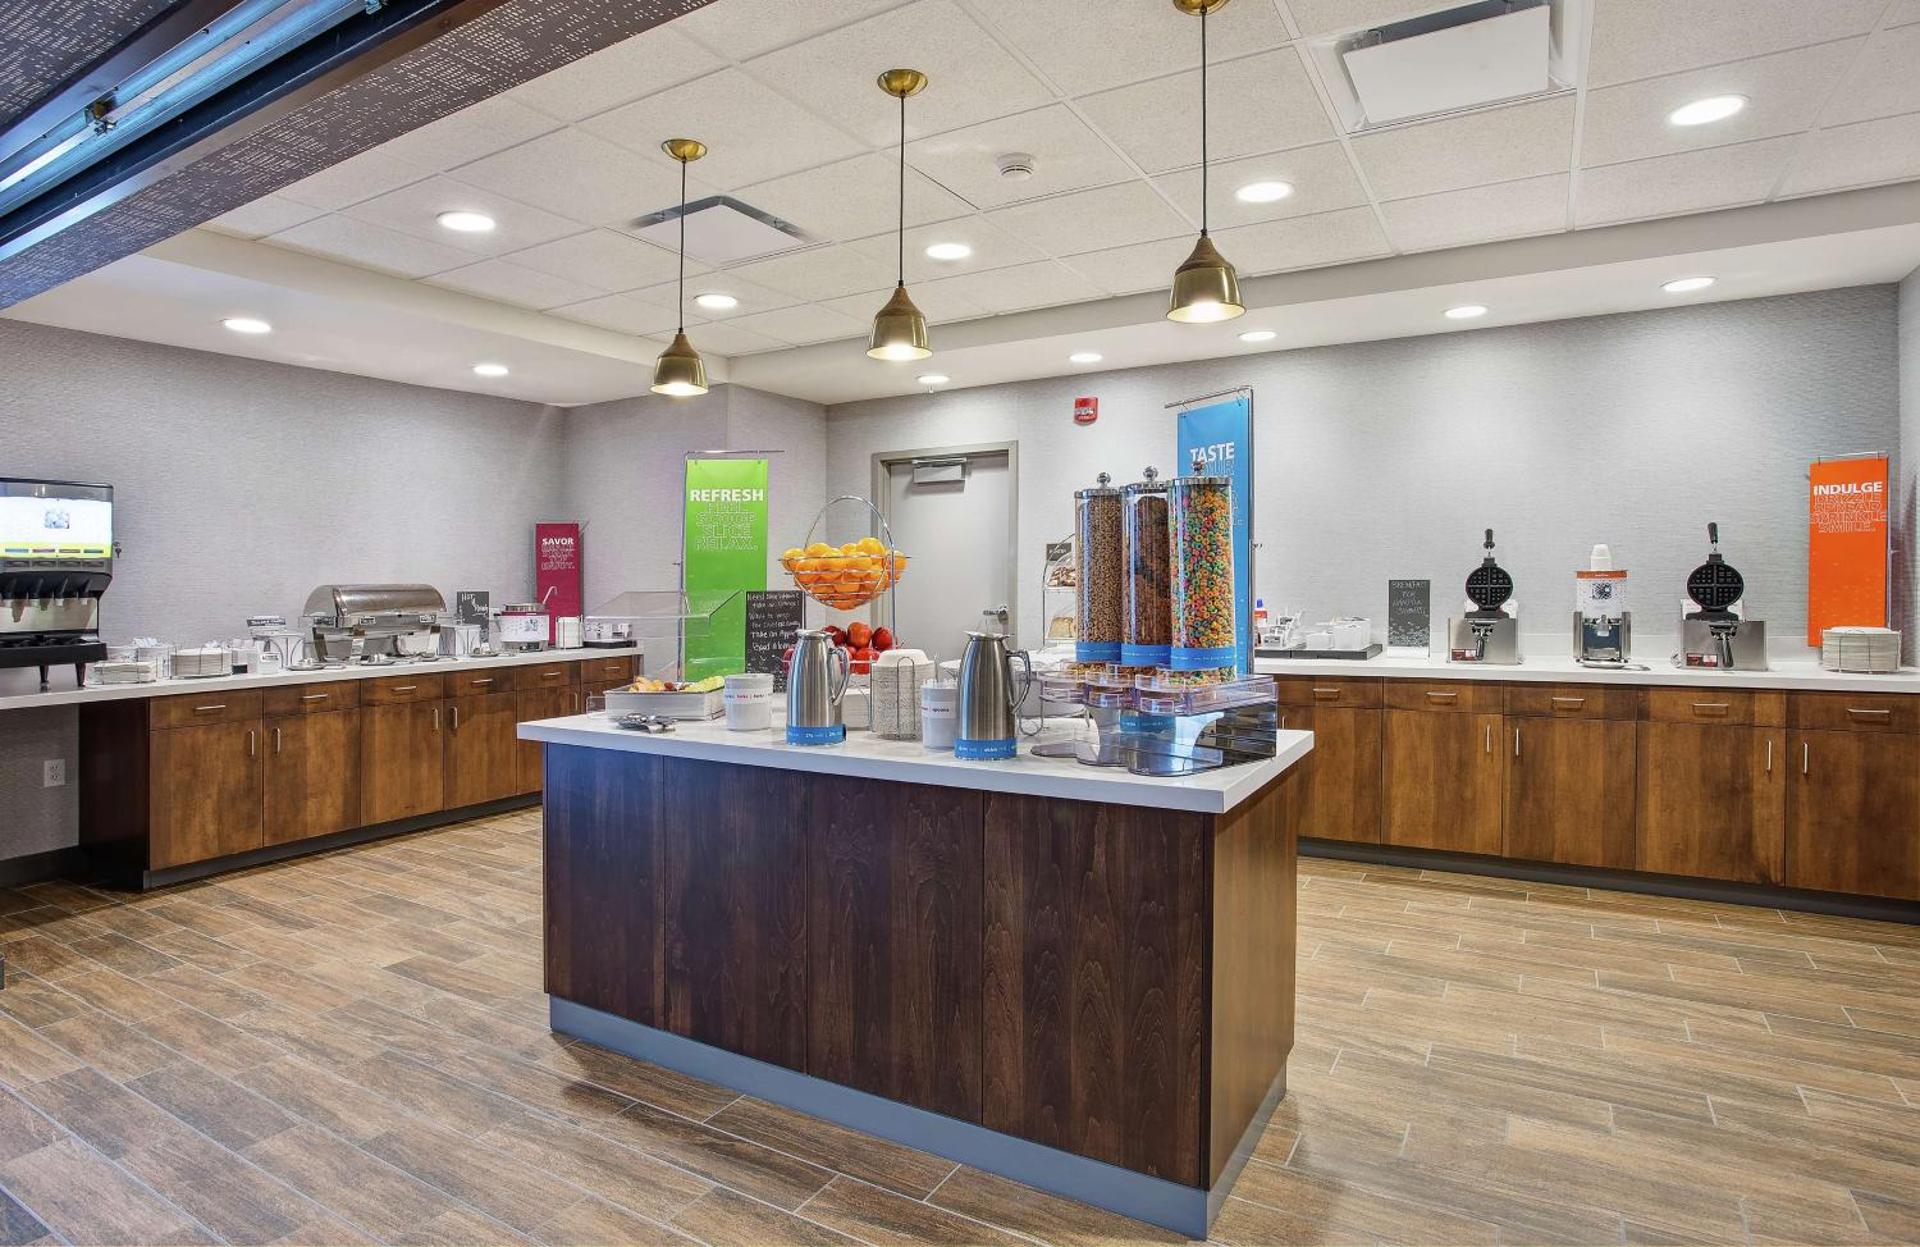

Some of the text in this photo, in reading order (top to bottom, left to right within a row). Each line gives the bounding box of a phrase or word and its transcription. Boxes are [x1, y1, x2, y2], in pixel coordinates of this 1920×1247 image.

[1190, 442, 1234, 463] TASTE
[690, 488, 764, 502] REFRESH
[1813, 481, 1883, 496] INDULGE
[703, 524, 751, 538] SLICE
[542, 537, 574, 545] SAVOR
